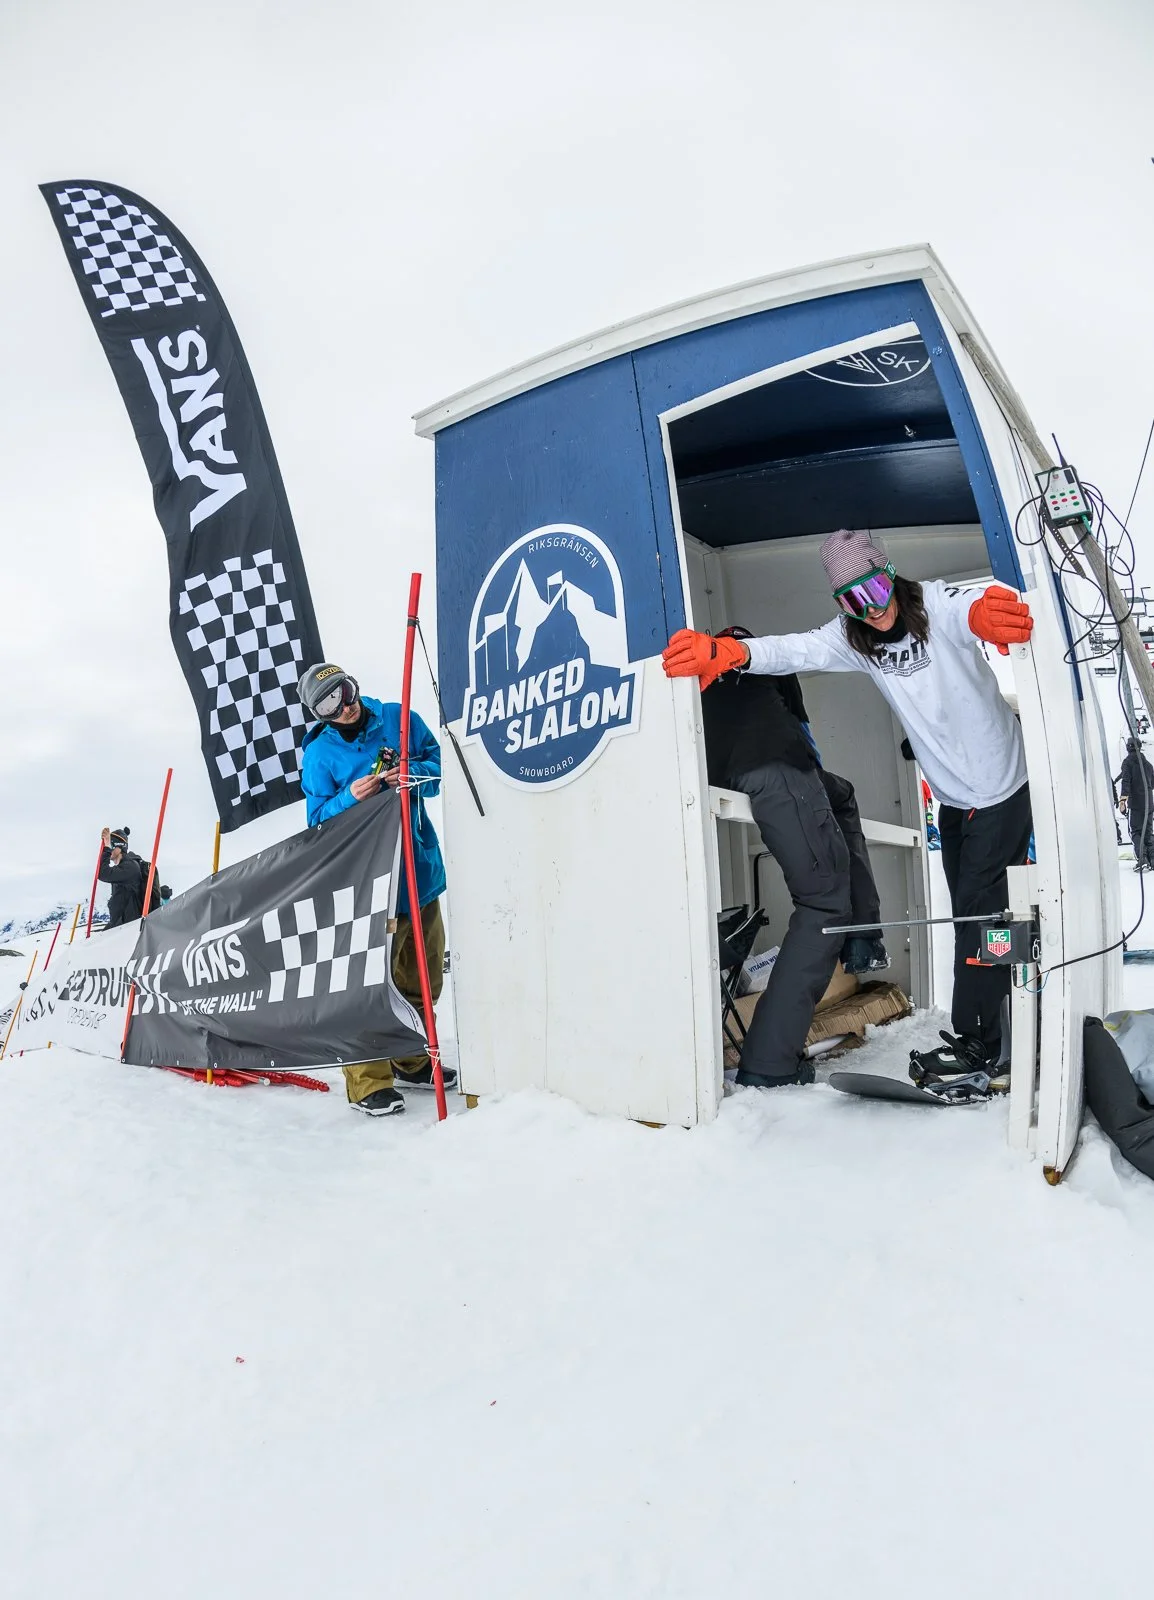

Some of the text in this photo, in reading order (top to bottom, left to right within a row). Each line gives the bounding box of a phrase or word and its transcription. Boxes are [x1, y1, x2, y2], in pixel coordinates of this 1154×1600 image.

[131, 329, 247, 532] VANS
[471, 657, 585, 730] BANKED
[504, 681, 630, 754] SLALOM
[519, 756, 574, 777] SNOWBOARD
[182, 917, 250, 987] VANS
[989, 943, 1010, 955] HEUER
[991, 931, 1007, 942] TAG
[194, 996, 219, 1015] THE
[218, 989, 263, 1013] WALL"
